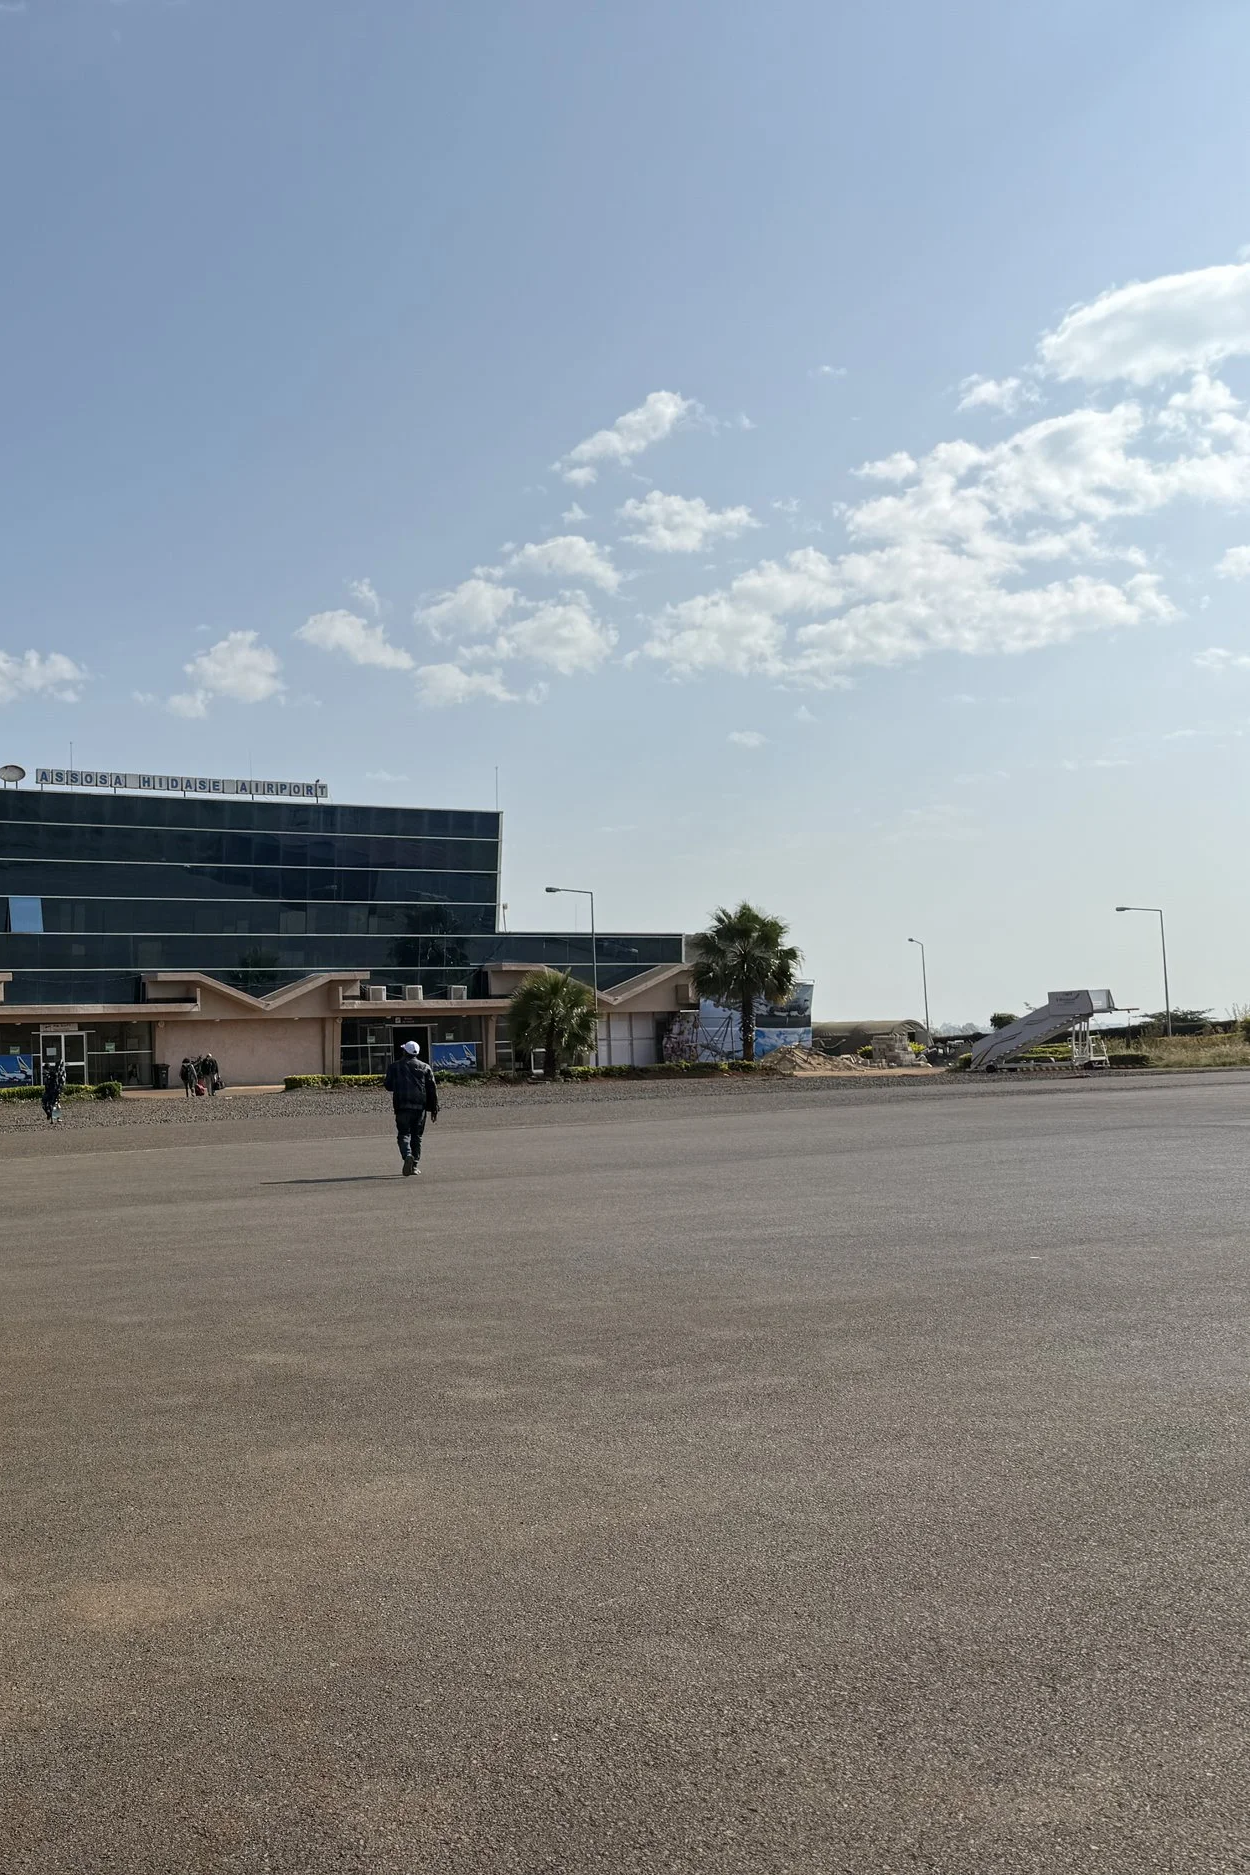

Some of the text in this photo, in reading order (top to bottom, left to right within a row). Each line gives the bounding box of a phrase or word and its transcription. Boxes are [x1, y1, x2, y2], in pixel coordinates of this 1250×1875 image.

[39, 770, 327, 796] ASSOSA HIDASE AIRPORT
